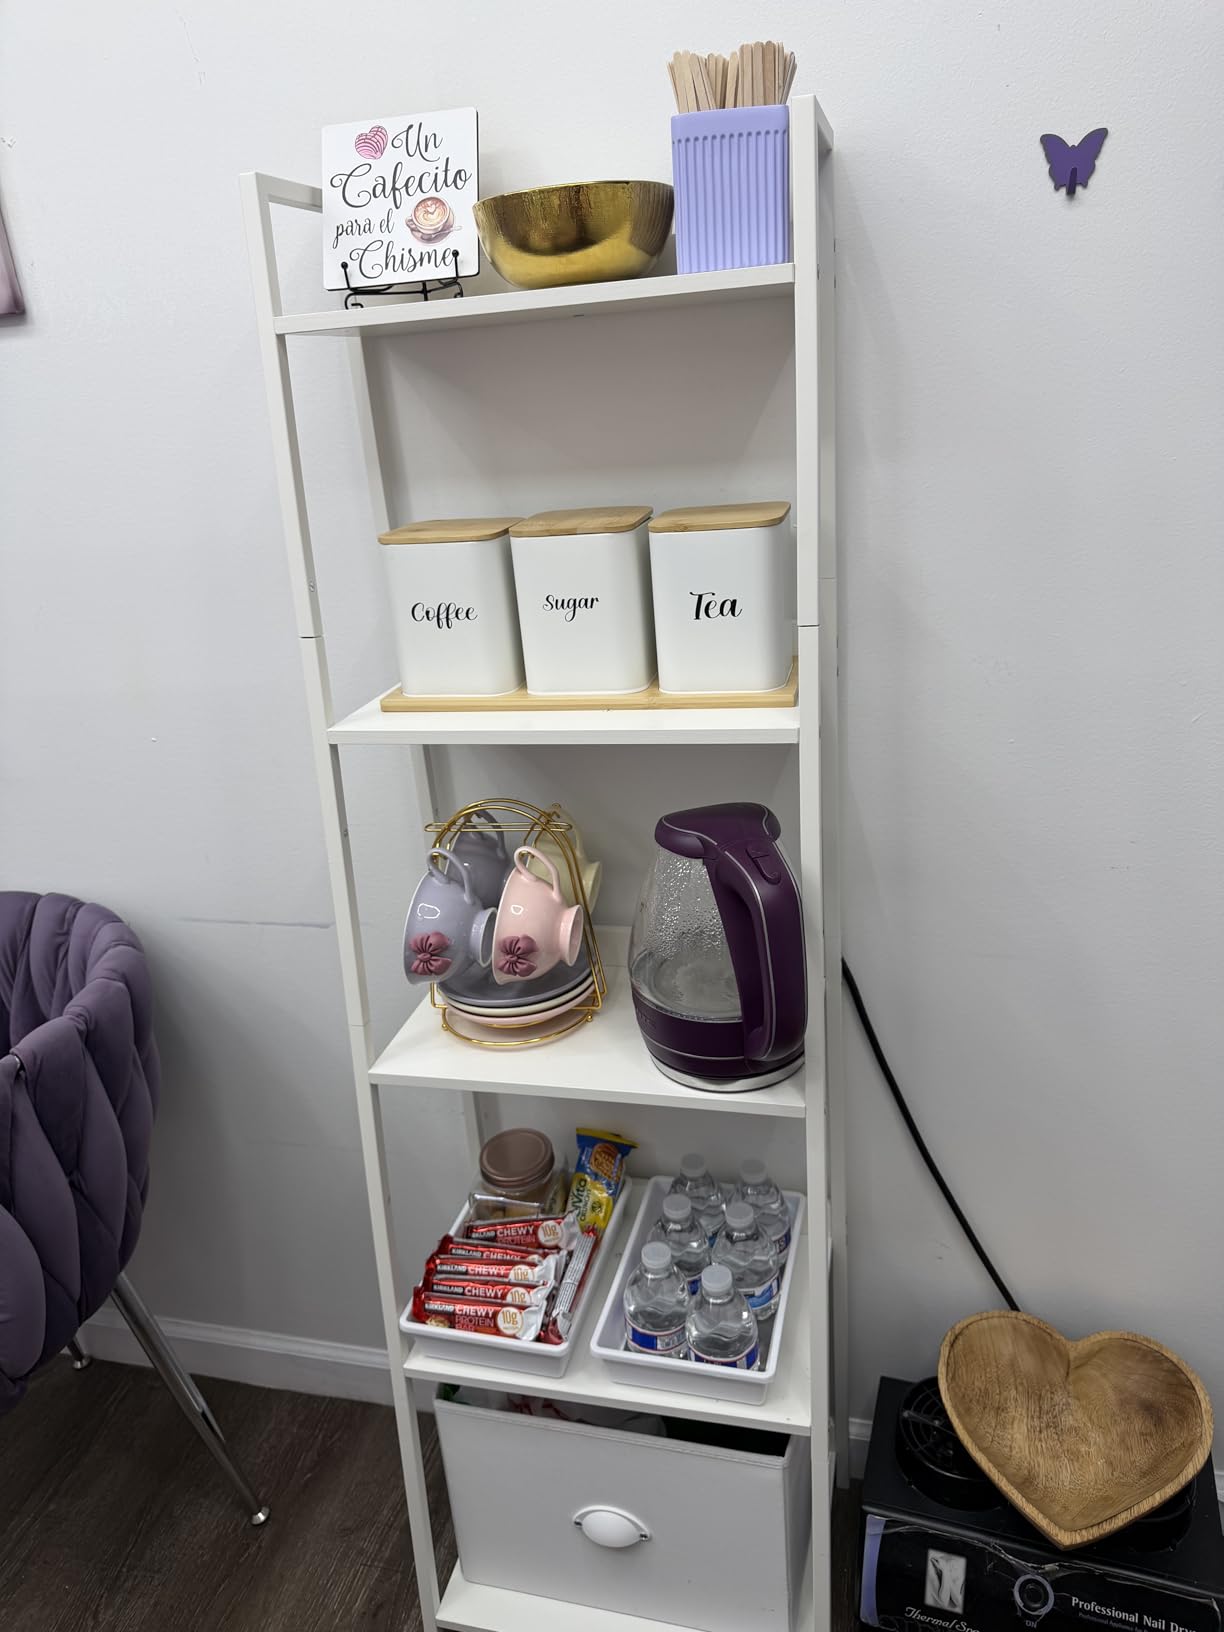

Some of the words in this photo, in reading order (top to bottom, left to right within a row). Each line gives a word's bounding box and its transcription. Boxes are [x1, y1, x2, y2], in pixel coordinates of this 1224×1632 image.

[391, 122, 443, 162] Un
[330, 157, 472, 209] Cafecito
[333, 217, 375, 249] para
[379, 208, 395, 234] el
[350, 239, 453, 279] Chisme
[542, 594, 600, 622] Sugar
[689, 591, 743, 620] Tea
[411, 602, 478, 629] Coffee
[496, 1225, 535, 1237] CHEWY
[541, 1223, 559, 1239] 10g
[451, 1248, 482, 1257] KIRKLAND
[437, 1264, 467, 1272] KIRKLAND
[467, 1265, 505, 1276] CHEWY
[433, 1284, 464, 1294] KIRKLAND
[464, 1287, 503, 1298] CHEWY
[455, 1304, 494, 1317] CHEWY
[502, 1310, 518, 1325] 10g
[455, 1315, 494, 1327] PROTEIN
[904, 1606, 957, 1629] Thermal
[1071, 1596, 1139, 1624] Professional
[1143, 1615, 1166, 1631] Nail
